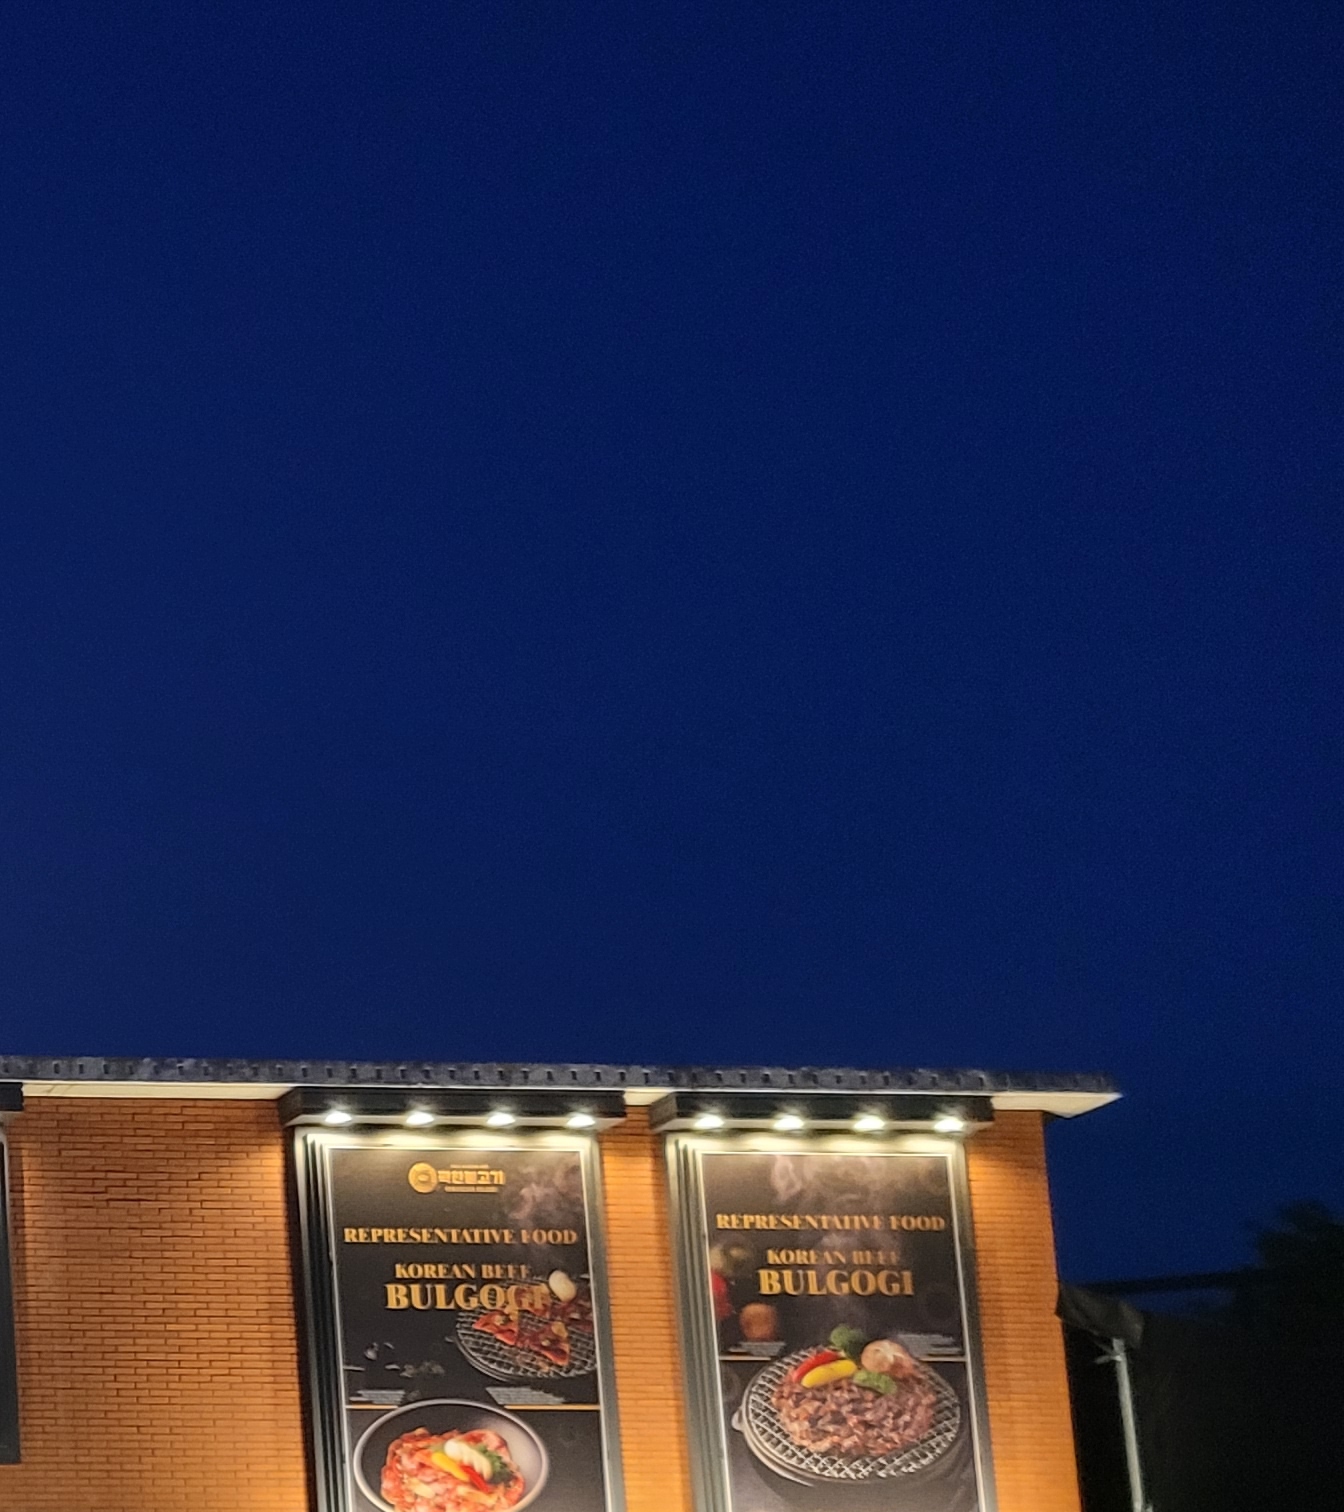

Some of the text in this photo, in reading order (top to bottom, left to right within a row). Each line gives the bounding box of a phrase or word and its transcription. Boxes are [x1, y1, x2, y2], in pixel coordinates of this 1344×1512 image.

[716, 1213, 945, 1232] REPRESENTATIVE FOOD
[343, 1228, 578, 1245] REPRESENTATIVE FOOD
[767, 1249, 847, 1266] KOREAN
[395, 1263, 531, 1280] KOREAN BEEF
[758, 1269, 914, 1296] BULGOGI
